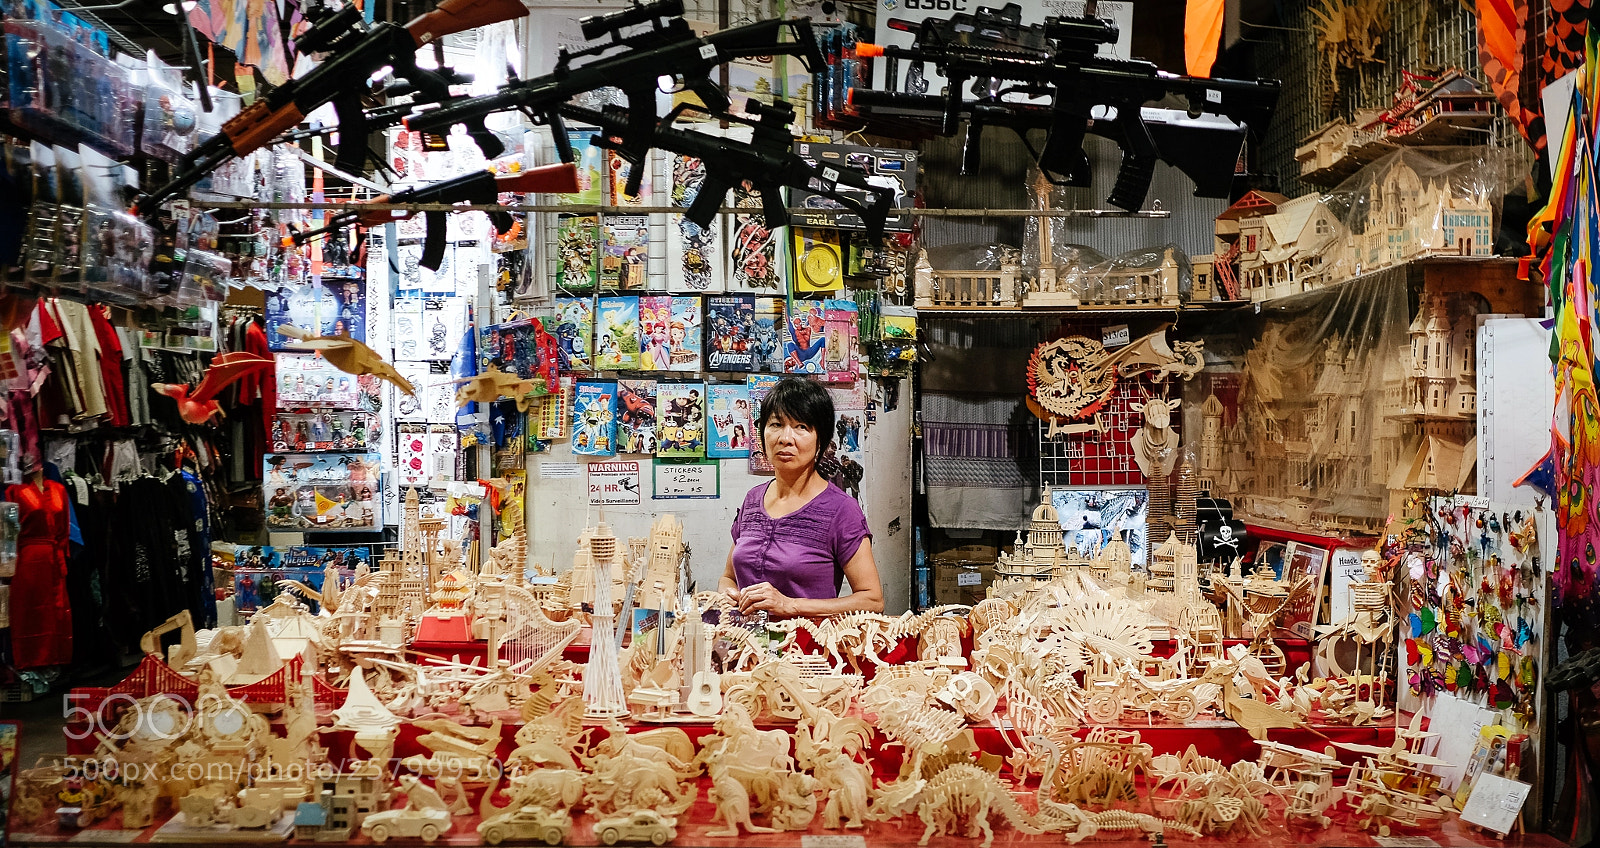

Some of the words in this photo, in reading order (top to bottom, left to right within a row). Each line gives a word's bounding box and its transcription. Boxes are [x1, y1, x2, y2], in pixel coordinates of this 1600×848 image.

[806, 217, 836, 227] EAGLE
[709, 350, 752, 367] AVENGERS
[589, 462, 637, 472] WARNING
[590, 484, 600, 492] 24
[604, 484, 621, 492] HR.
[284, 553, 317, 566] HEROES
